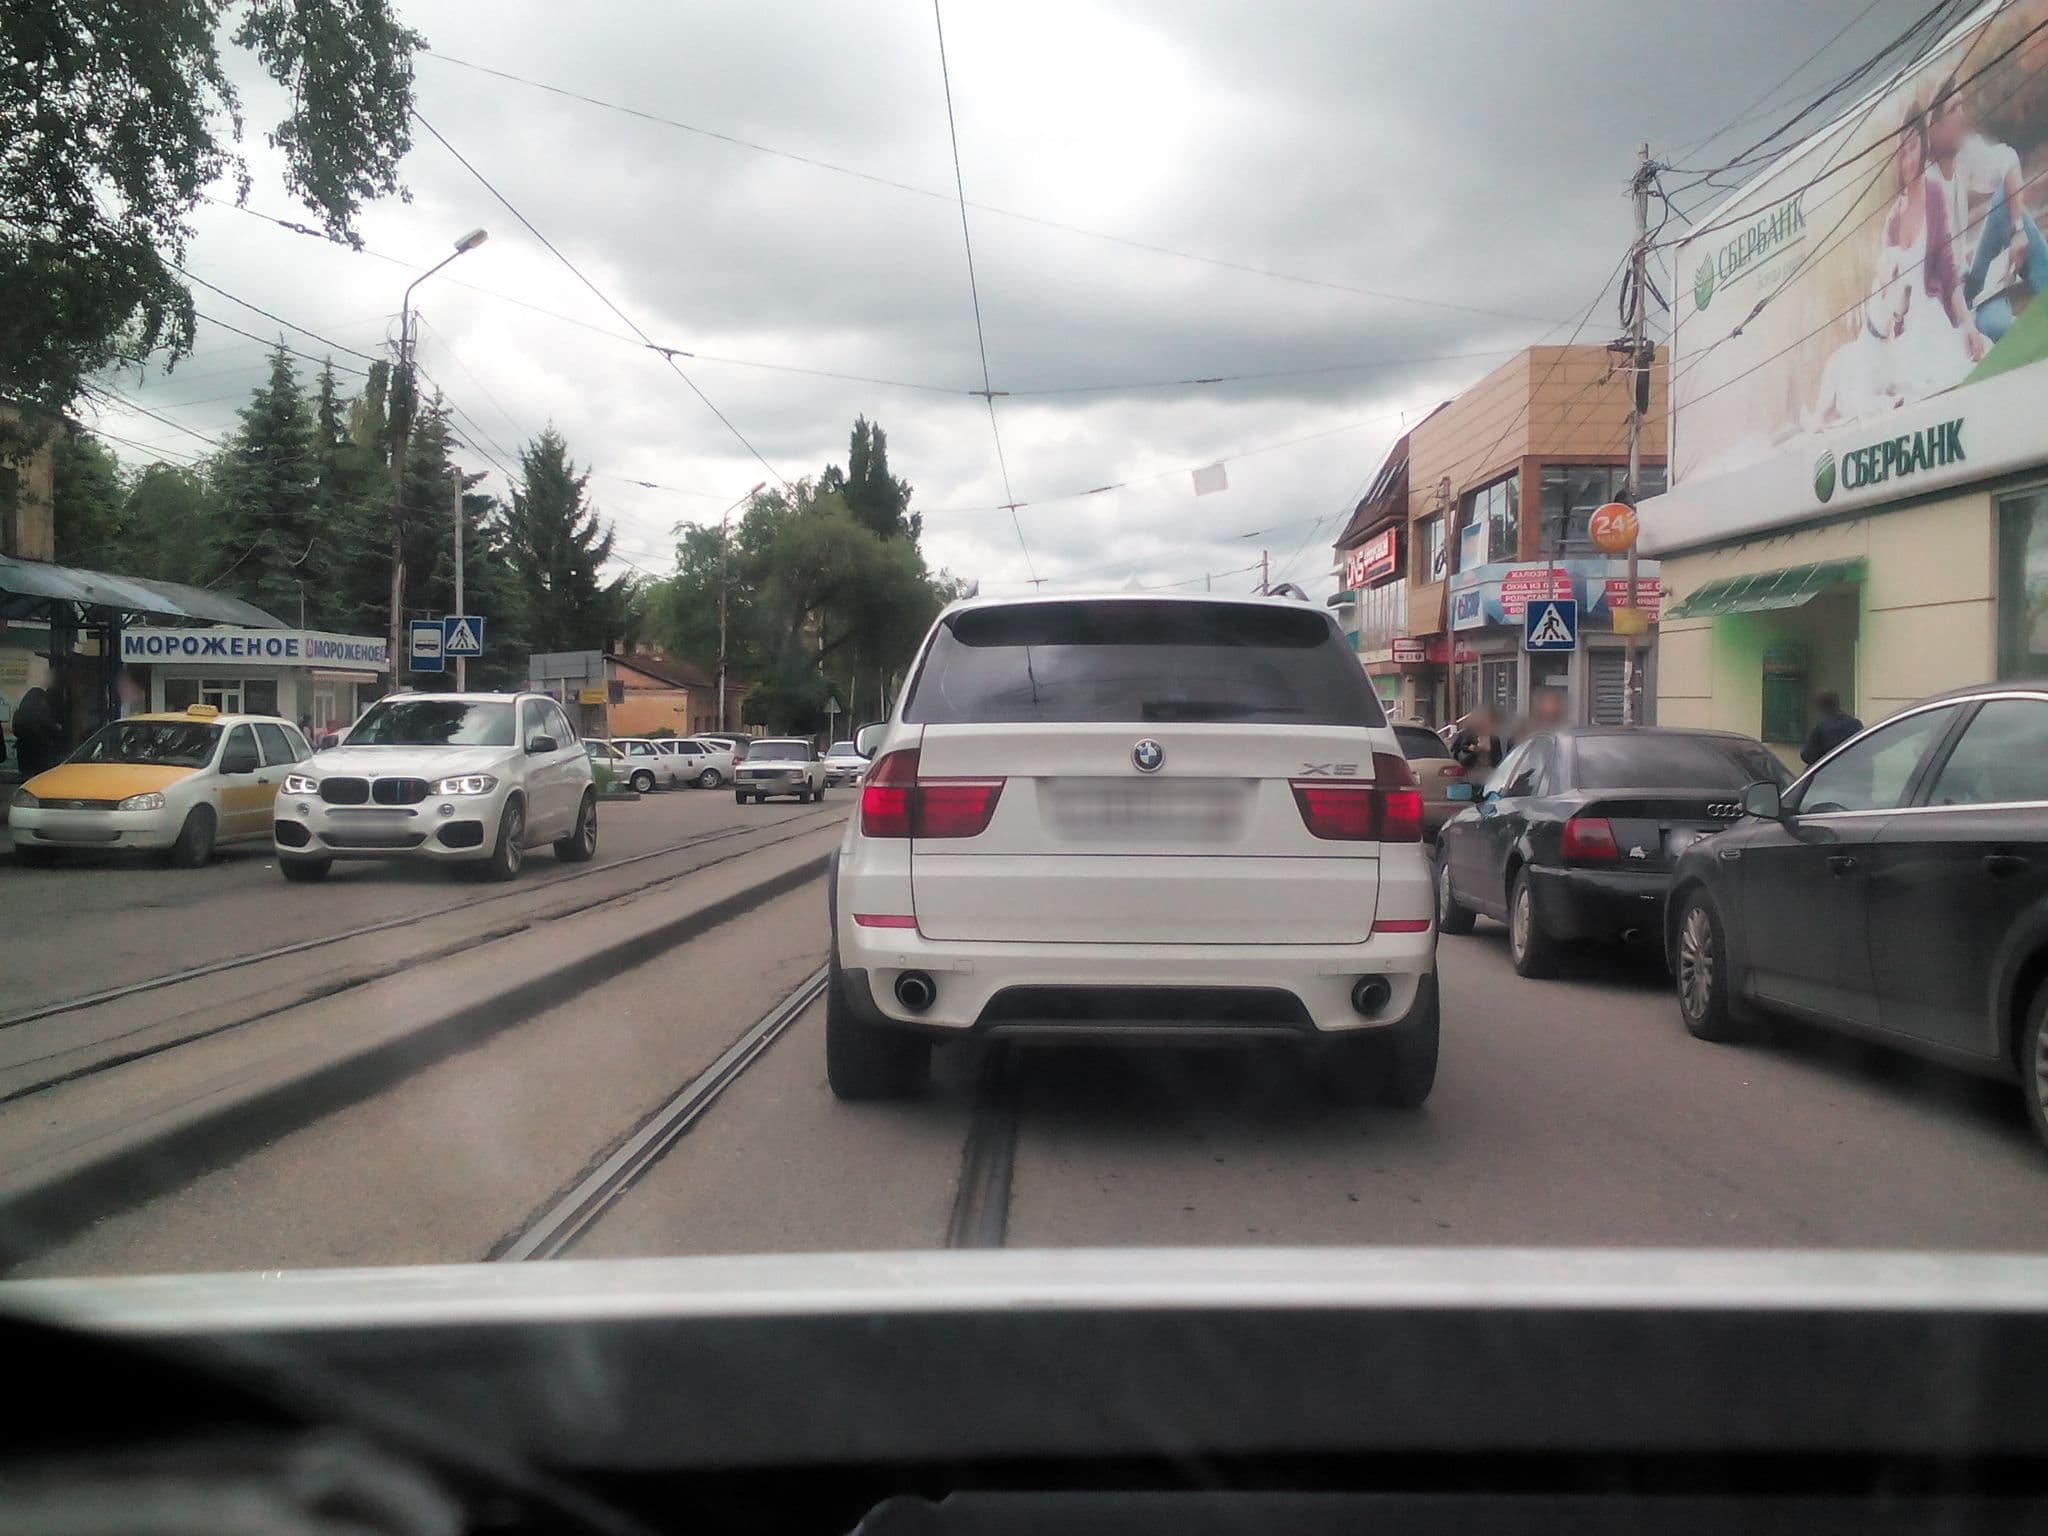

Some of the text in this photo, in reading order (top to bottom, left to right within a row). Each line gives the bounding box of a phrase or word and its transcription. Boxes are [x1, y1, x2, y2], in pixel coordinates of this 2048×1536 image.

[1719, 194, 1806, 280] СБЕРБАНК
[1841, 418, 1966, 490] СБЕРБАНК
[1506, 582, 1528, 590] ОКНА
[1543, 581, 1560, 589] ПХ
[124, 636, 299, 658] МОРОЖЕНОЕ
[314, 640, 380, 661] МОРОЖЕНОЕ
[1299, 763, 1359, 776] X5
